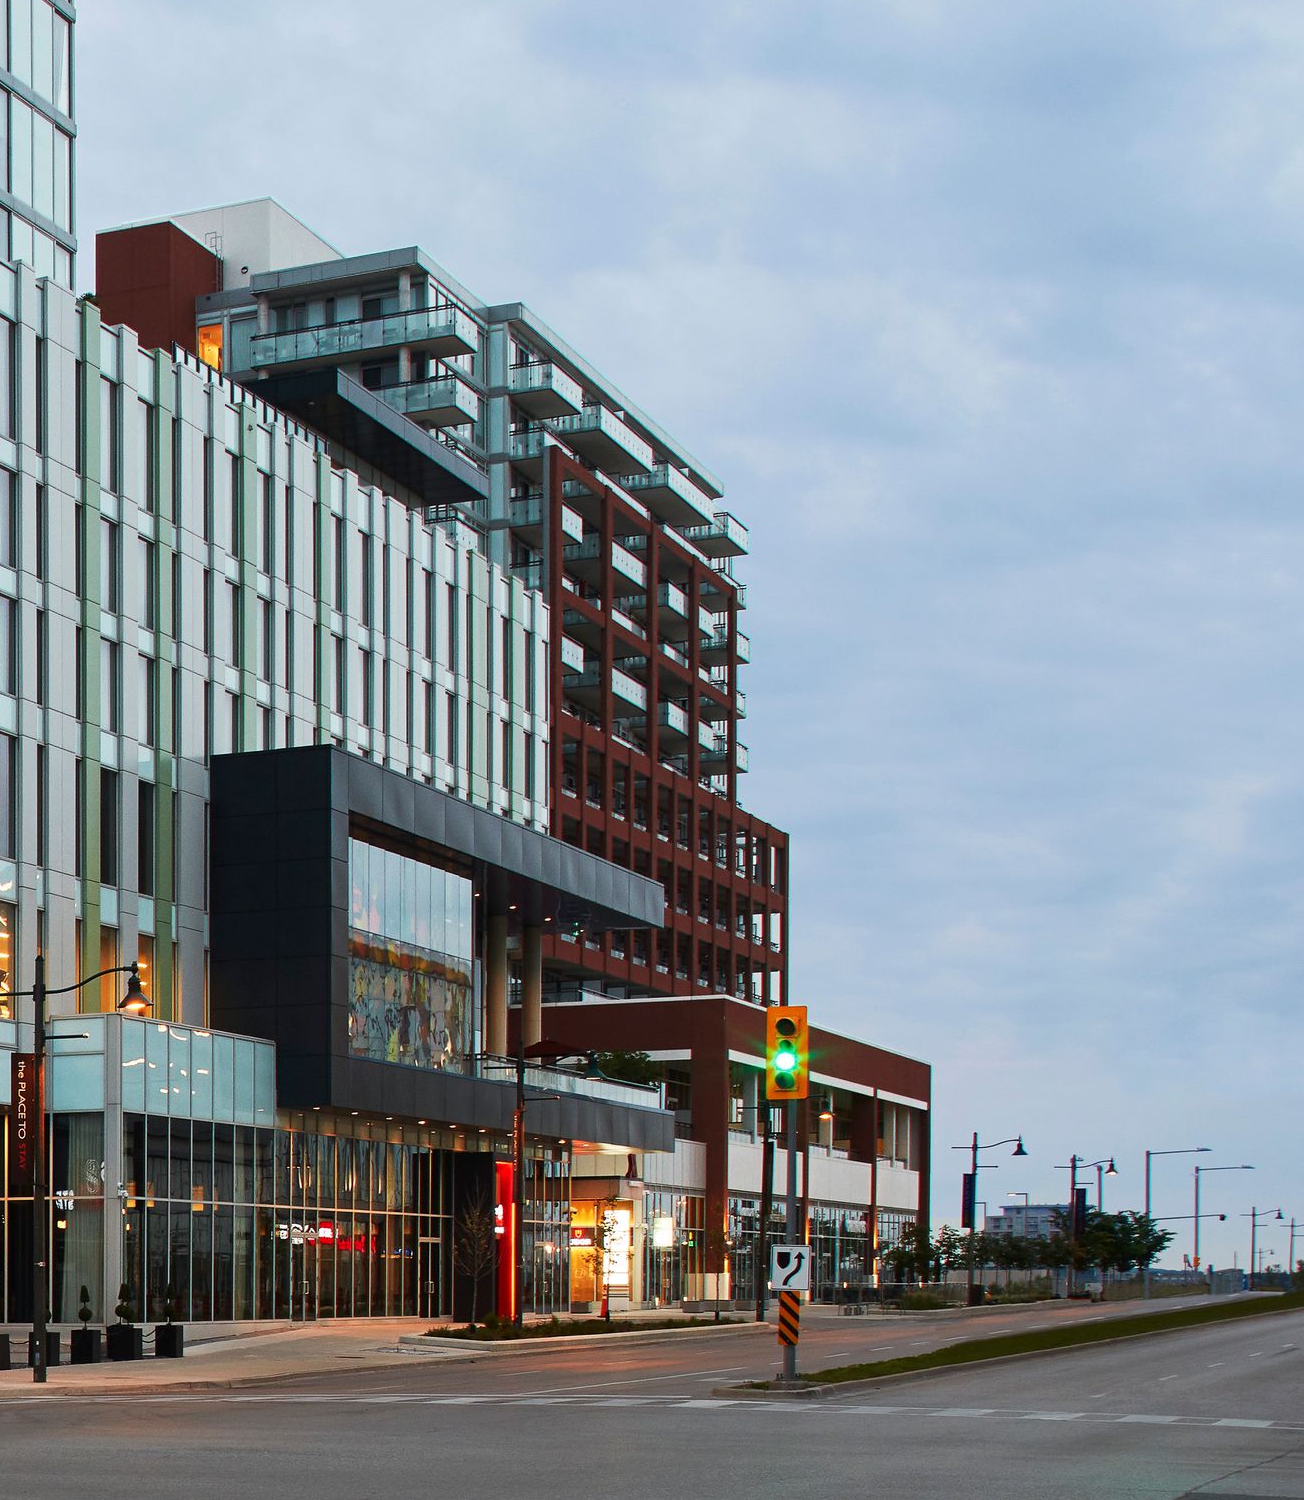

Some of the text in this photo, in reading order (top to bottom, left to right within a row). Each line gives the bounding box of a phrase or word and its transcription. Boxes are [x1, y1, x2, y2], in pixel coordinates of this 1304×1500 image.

[17, 1061, 27, 1170] the PLACE TO STAY
